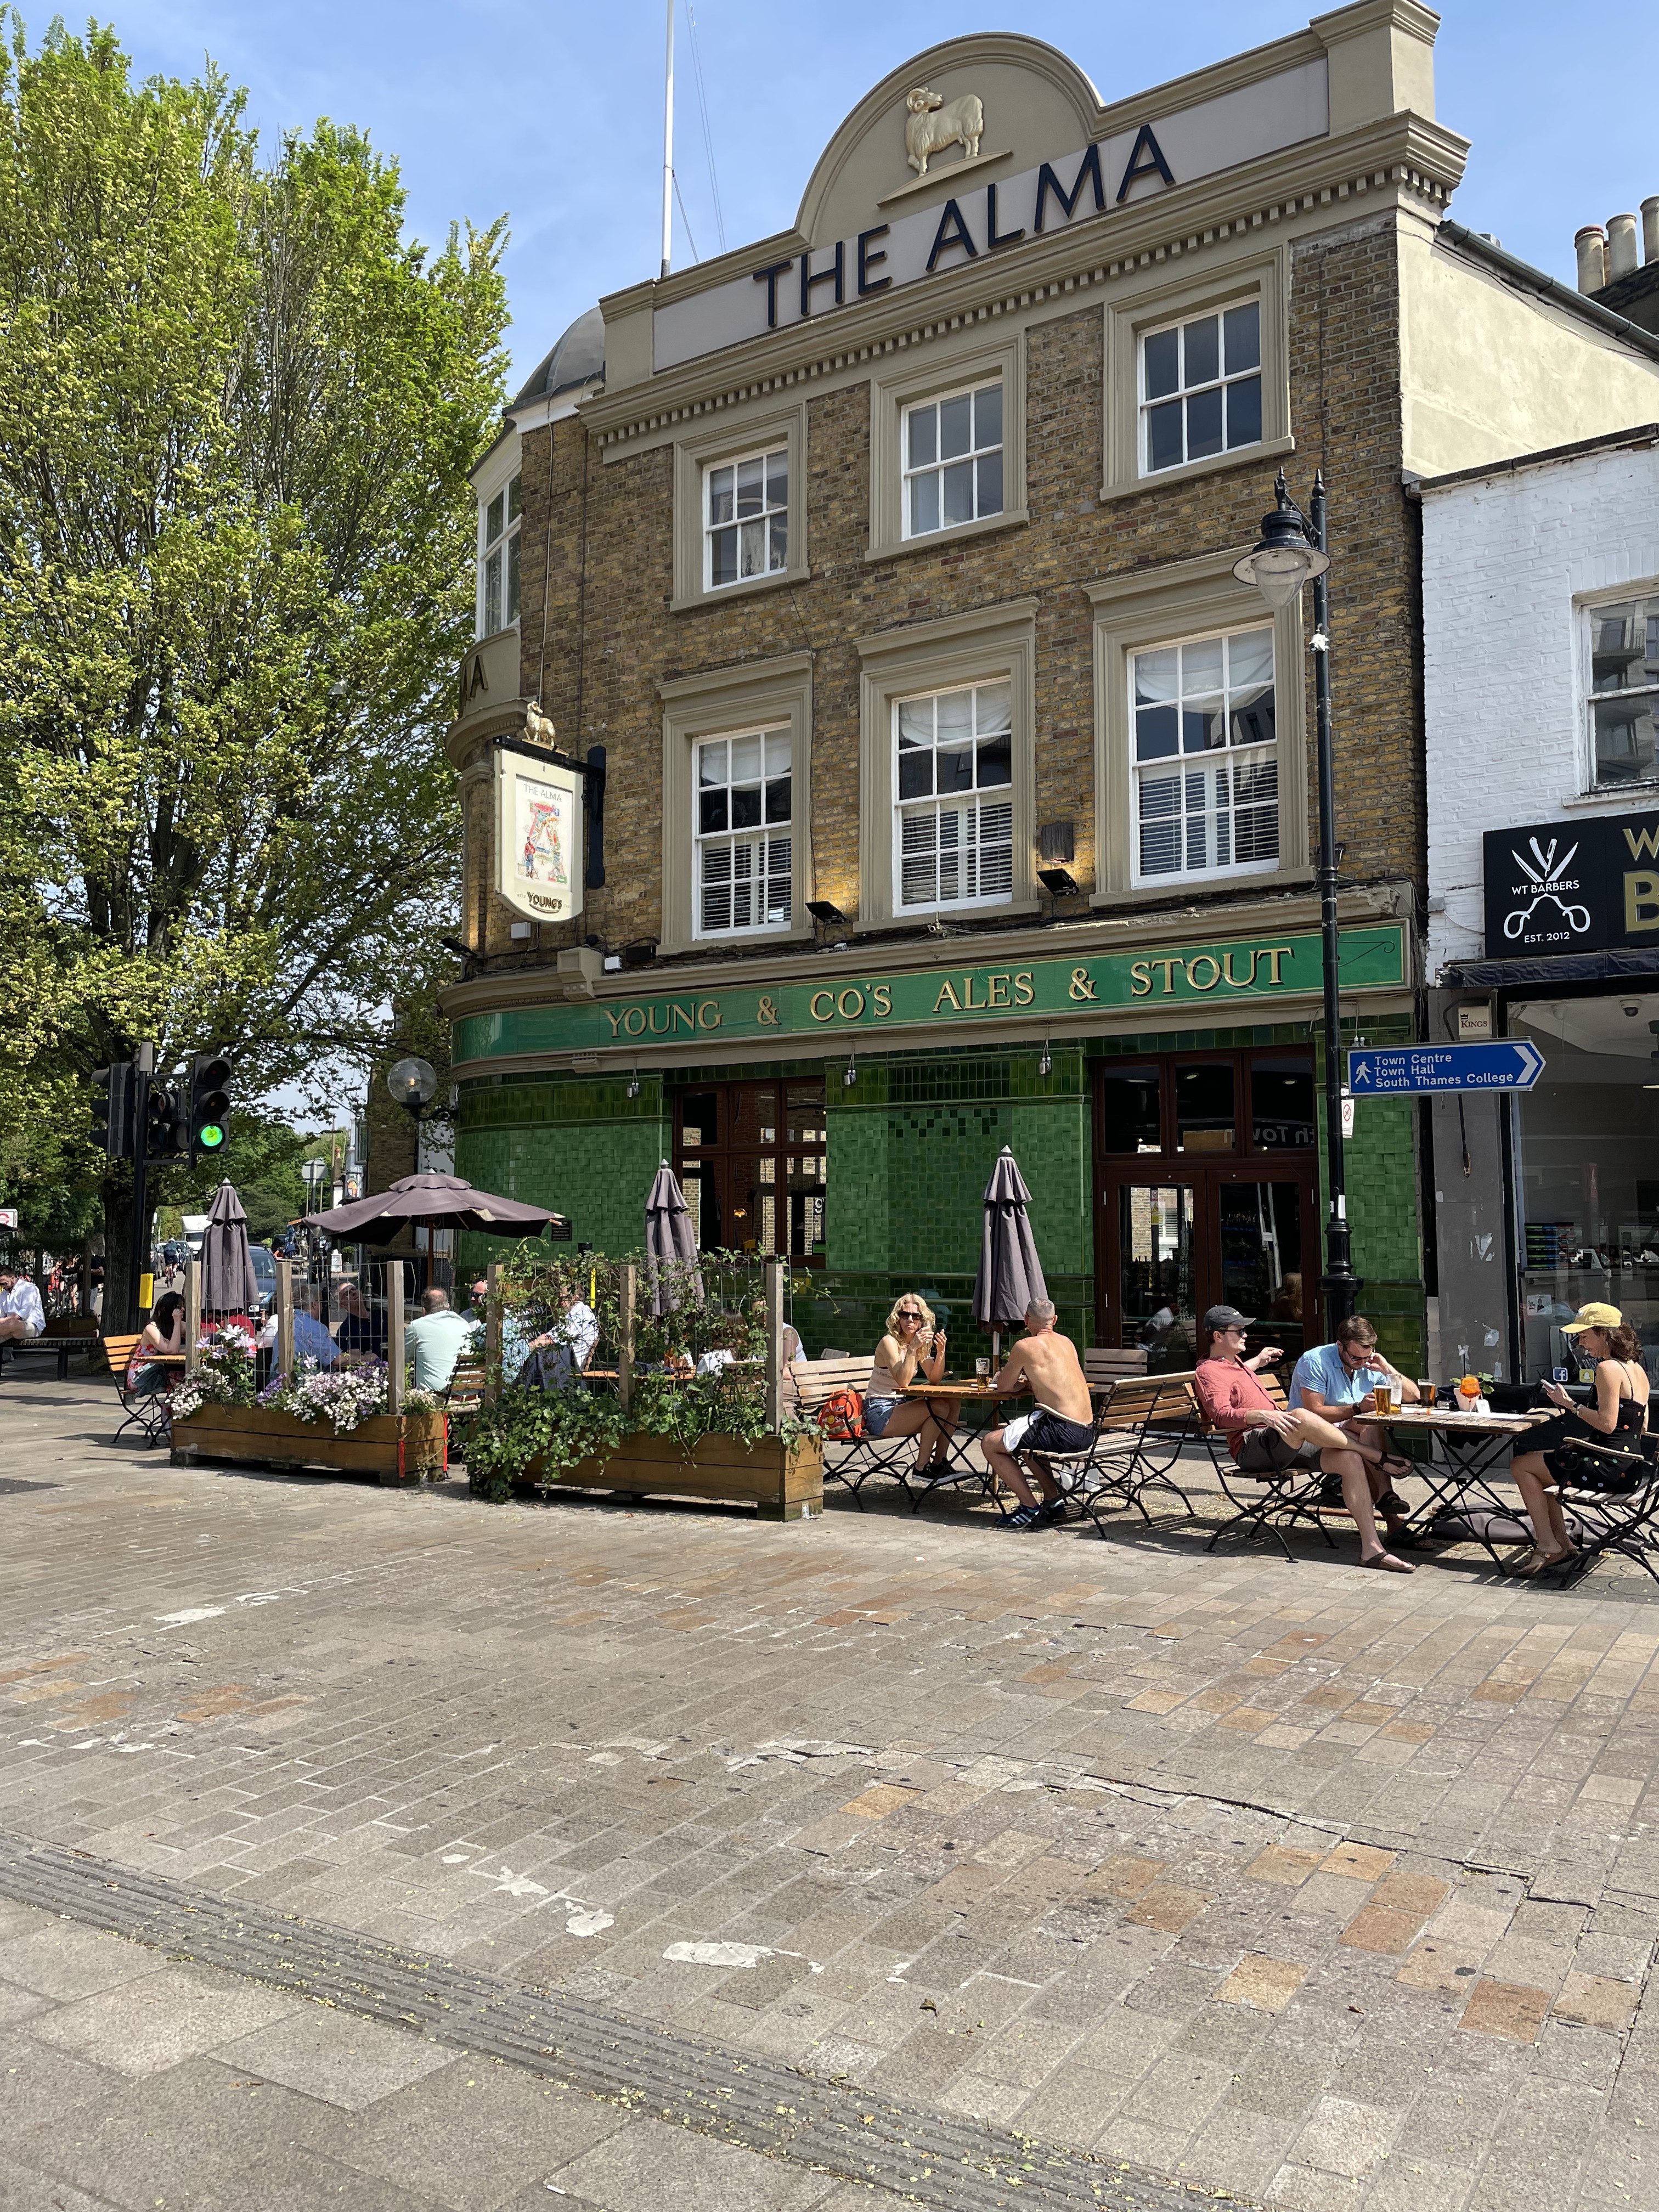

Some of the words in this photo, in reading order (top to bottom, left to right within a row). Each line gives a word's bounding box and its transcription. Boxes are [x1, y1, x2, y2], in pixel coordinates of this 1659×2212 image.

[753, 223, 893, 328] THE
[925, 123, 1176, 272] ALMA
[524, 784, 538, 795] THE
[540, 789, 562, 803] ALMA
[1511, 884, 1528, 895] WT
[1531, 879, 1580, 894] BARBERS
[1524, 934, 1544, 943] EST.
[1546, 932, 1570, 941] 2012
[604, 1001, 723, 1037] YOUNG
[757, 995, 782, 1026] &
[810, 983, 893, 1022] CO'S
[932, 971, 1036, 1013] ALES
[1068, 967, 1101, 1002] &
[1131, 946, 1295, 997] STOUT
[1374, 1056, 1406, 1066] Town
[1411, 1053, 1452, 1064] Centre
[1374, 1067, 1405, 1076] Town
[1410, 1064, 1435, 1075] Hall
[1375, 1077, 1410, 1088] South
[1415, 1075, 1462, 1086] Thames
[1466, 1073, 1514, 1084] College
